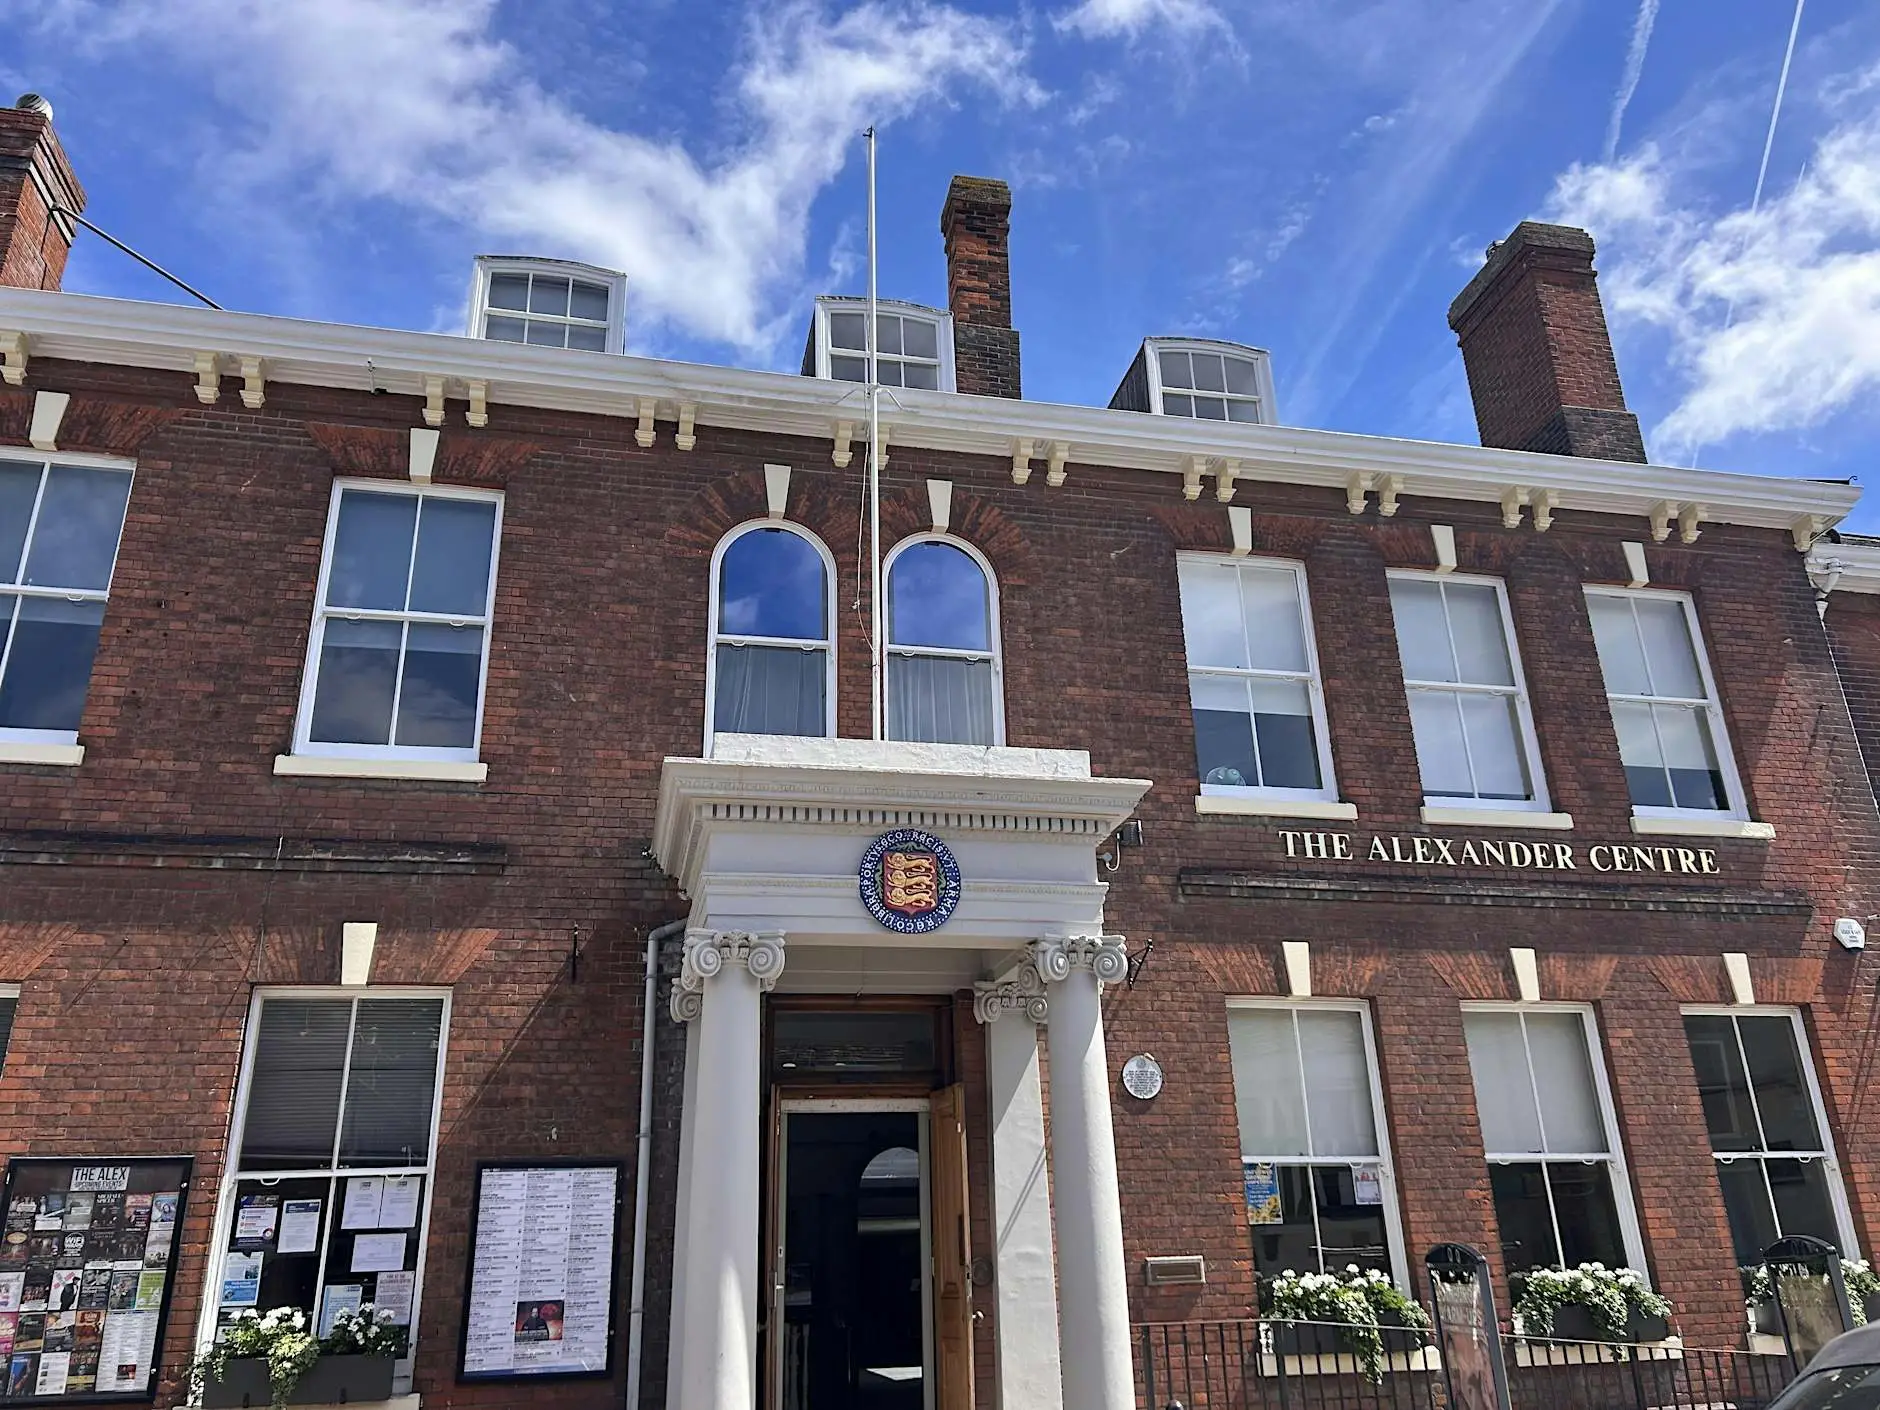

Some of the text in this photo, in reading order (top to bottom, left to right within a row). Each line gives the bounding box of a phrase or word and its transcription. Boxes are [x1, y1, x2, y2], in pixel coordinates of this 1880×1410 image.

[1278, 830, 1720, 875] THE ALEXANDER CENTRE
[938, 879, 956, 916] ARMA
[74, 1167, 127, 1181] THE ALEX
